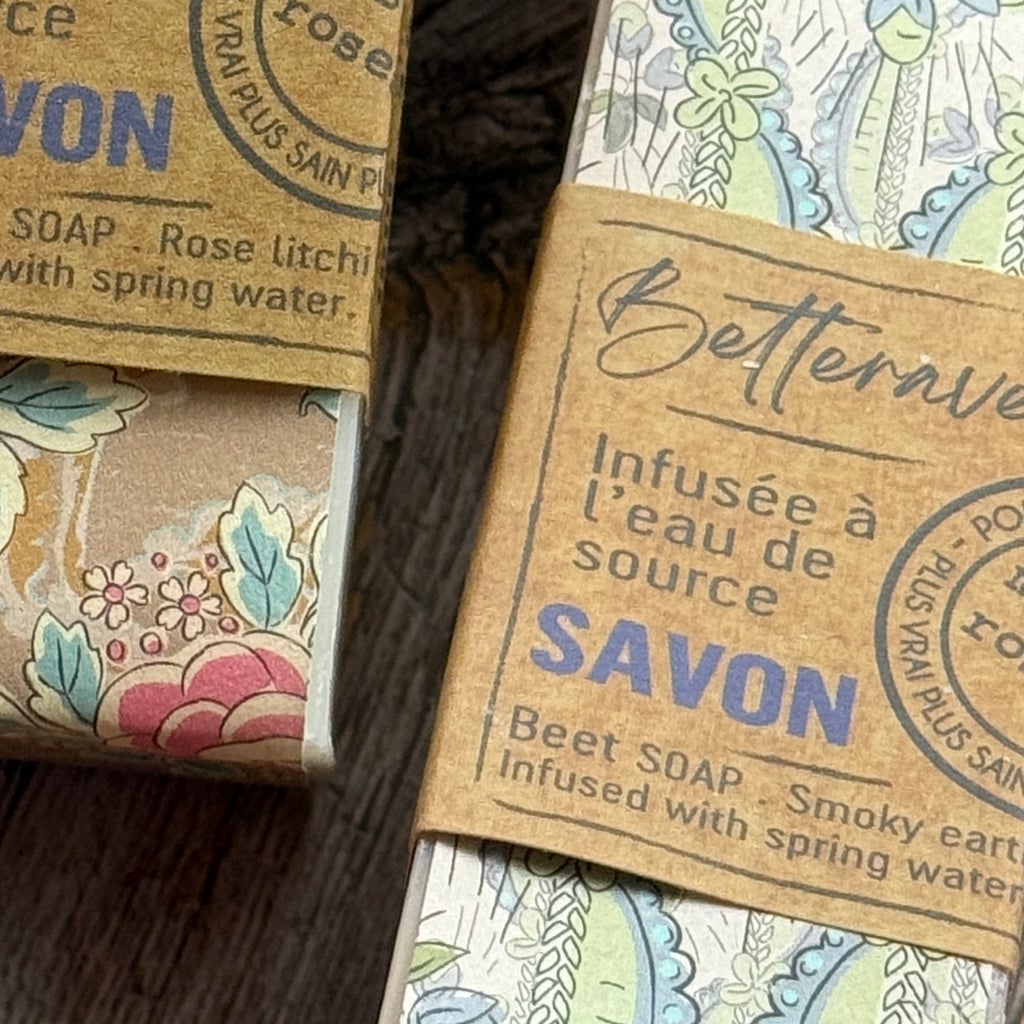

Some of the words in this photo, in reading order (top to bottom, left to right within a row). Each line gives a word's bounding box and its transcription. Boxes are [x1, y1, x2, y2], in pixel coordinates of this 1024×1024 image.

[214, 10, 250, 80] VRAI
[229, 81, 289, 150] PLUS
[285, 140, 352, 191] SAIN
[10, 207, 117, 249] SOAP
[159, 222, 255, 265] Rose
[271, 233, 372, 279] litchi
[91, 266, 214, 309] spring
[230, 280, 358, 321] water.
[591, 432, 818, 526] Infusée
[844, 493, 877, 541] à
[970, 499, 1024, 543] PO
[584, 479, 736, 558] l'eau
[764, 528, 836, 580] de
[572, 538, 779, 617] source
[904, 549, 956, 613] PLUS
[530, 602, 858, 748] SAVON
[899, 620, 936, 682] VRAI
[959, 611, 1024, 673] ro
[911, 686, 972, 751] PLUS
[499, 749, 651, 813] Infused
[665, 797, 748, 842] with
[764, 825, 891, 881] spring
[507, 704, 620, 765] Beet
[636, 742, 744, 795] SOAP
[785, 783, 925, 845] Smoky
[940, 825, 1024, 866] eart
